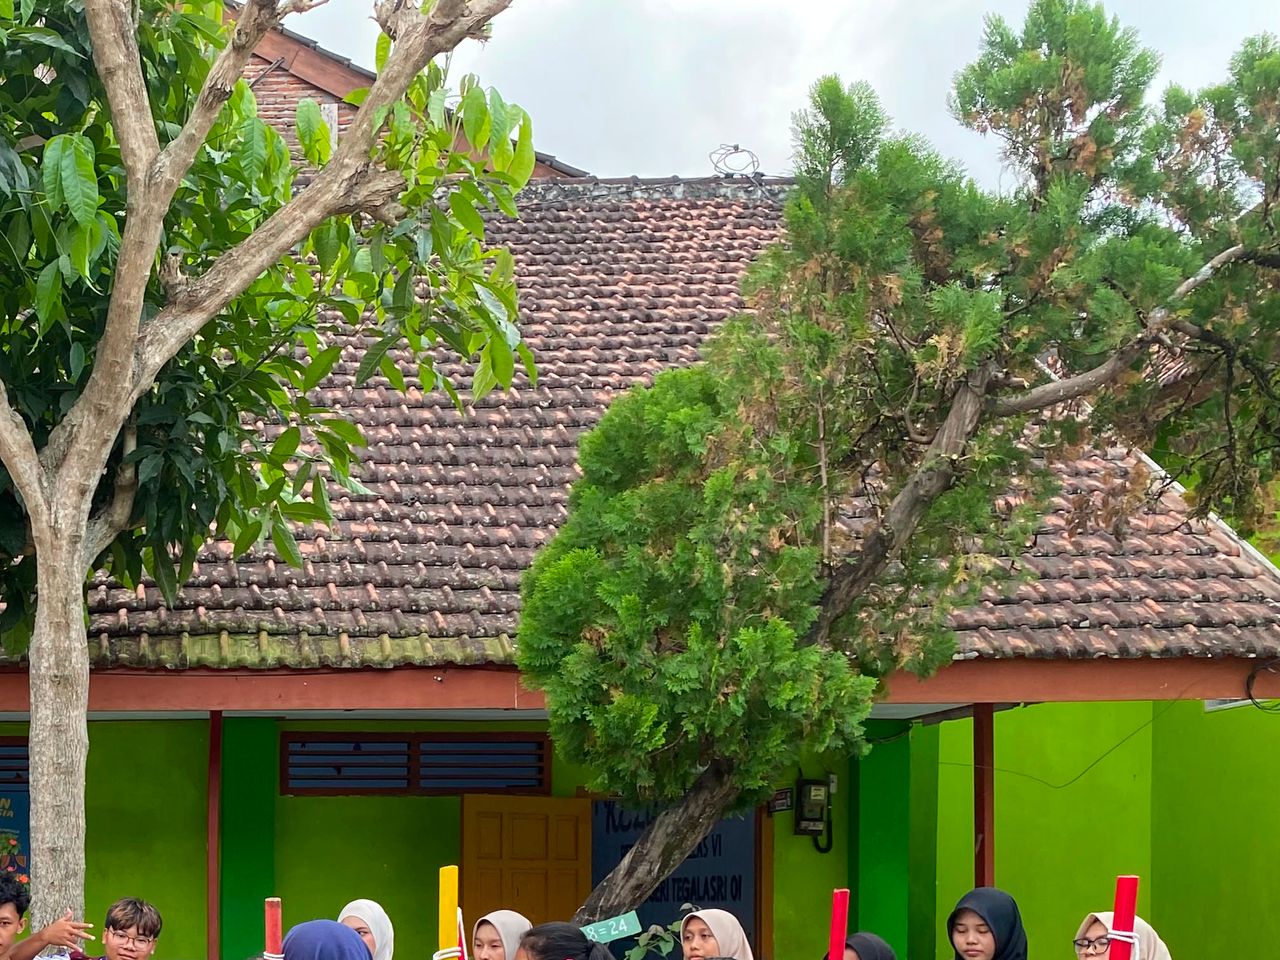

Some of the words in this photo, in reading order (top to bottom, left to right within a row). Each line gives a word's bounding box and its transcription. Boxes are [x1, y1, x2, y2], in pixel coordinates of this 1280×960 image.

[671, 875, 727, 902] TEGALASRI
[586, 927, 598, 943] 8
[608, 917, 628, 936] 24
